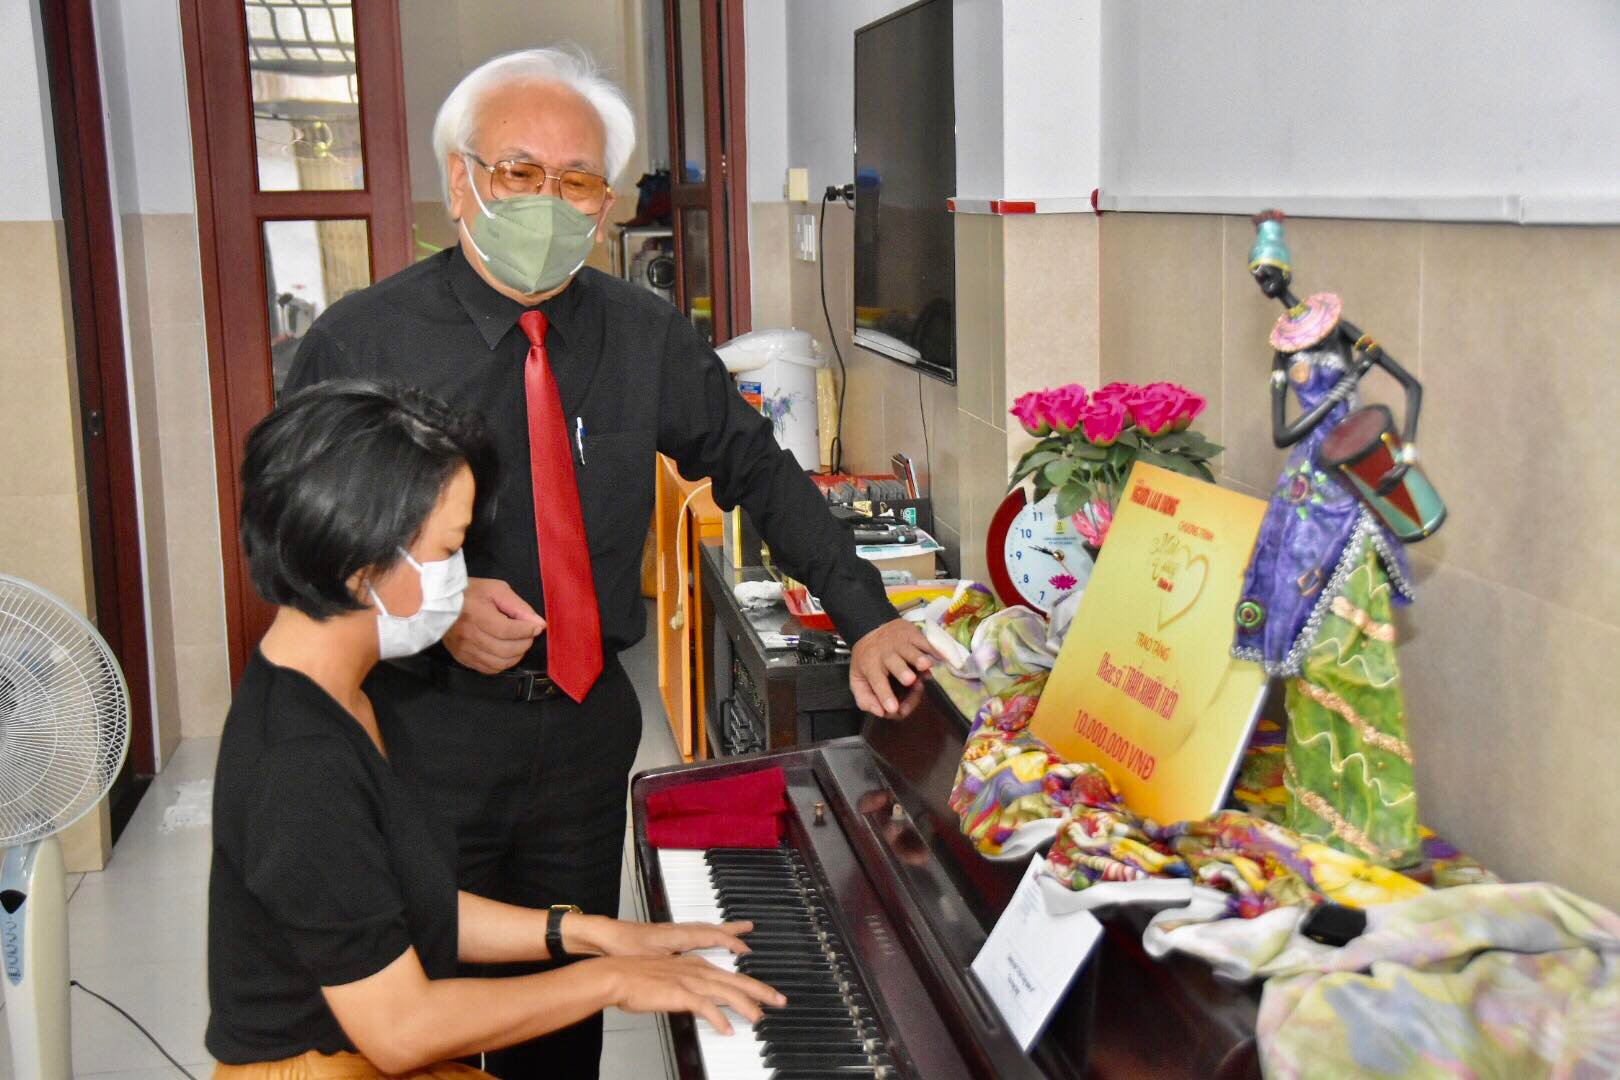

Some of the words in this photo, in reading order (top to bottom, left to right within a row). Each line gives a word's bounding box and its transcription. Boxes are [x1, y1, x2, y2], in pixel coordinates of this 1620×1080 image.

[1033, 512, 1043, 521] 11
[1020, 529, 1032, 538] 10
[1016, 551, 1022, 560] 9
[1023, 574, 1029, 583] 8
[1040, 591, 1045, 600] 7
[1136, 631, 1153, 651] TRAO
[1073, 709, 1129, 762] 10.000.000
[1126, 743, 1155, 780] VNĐ
